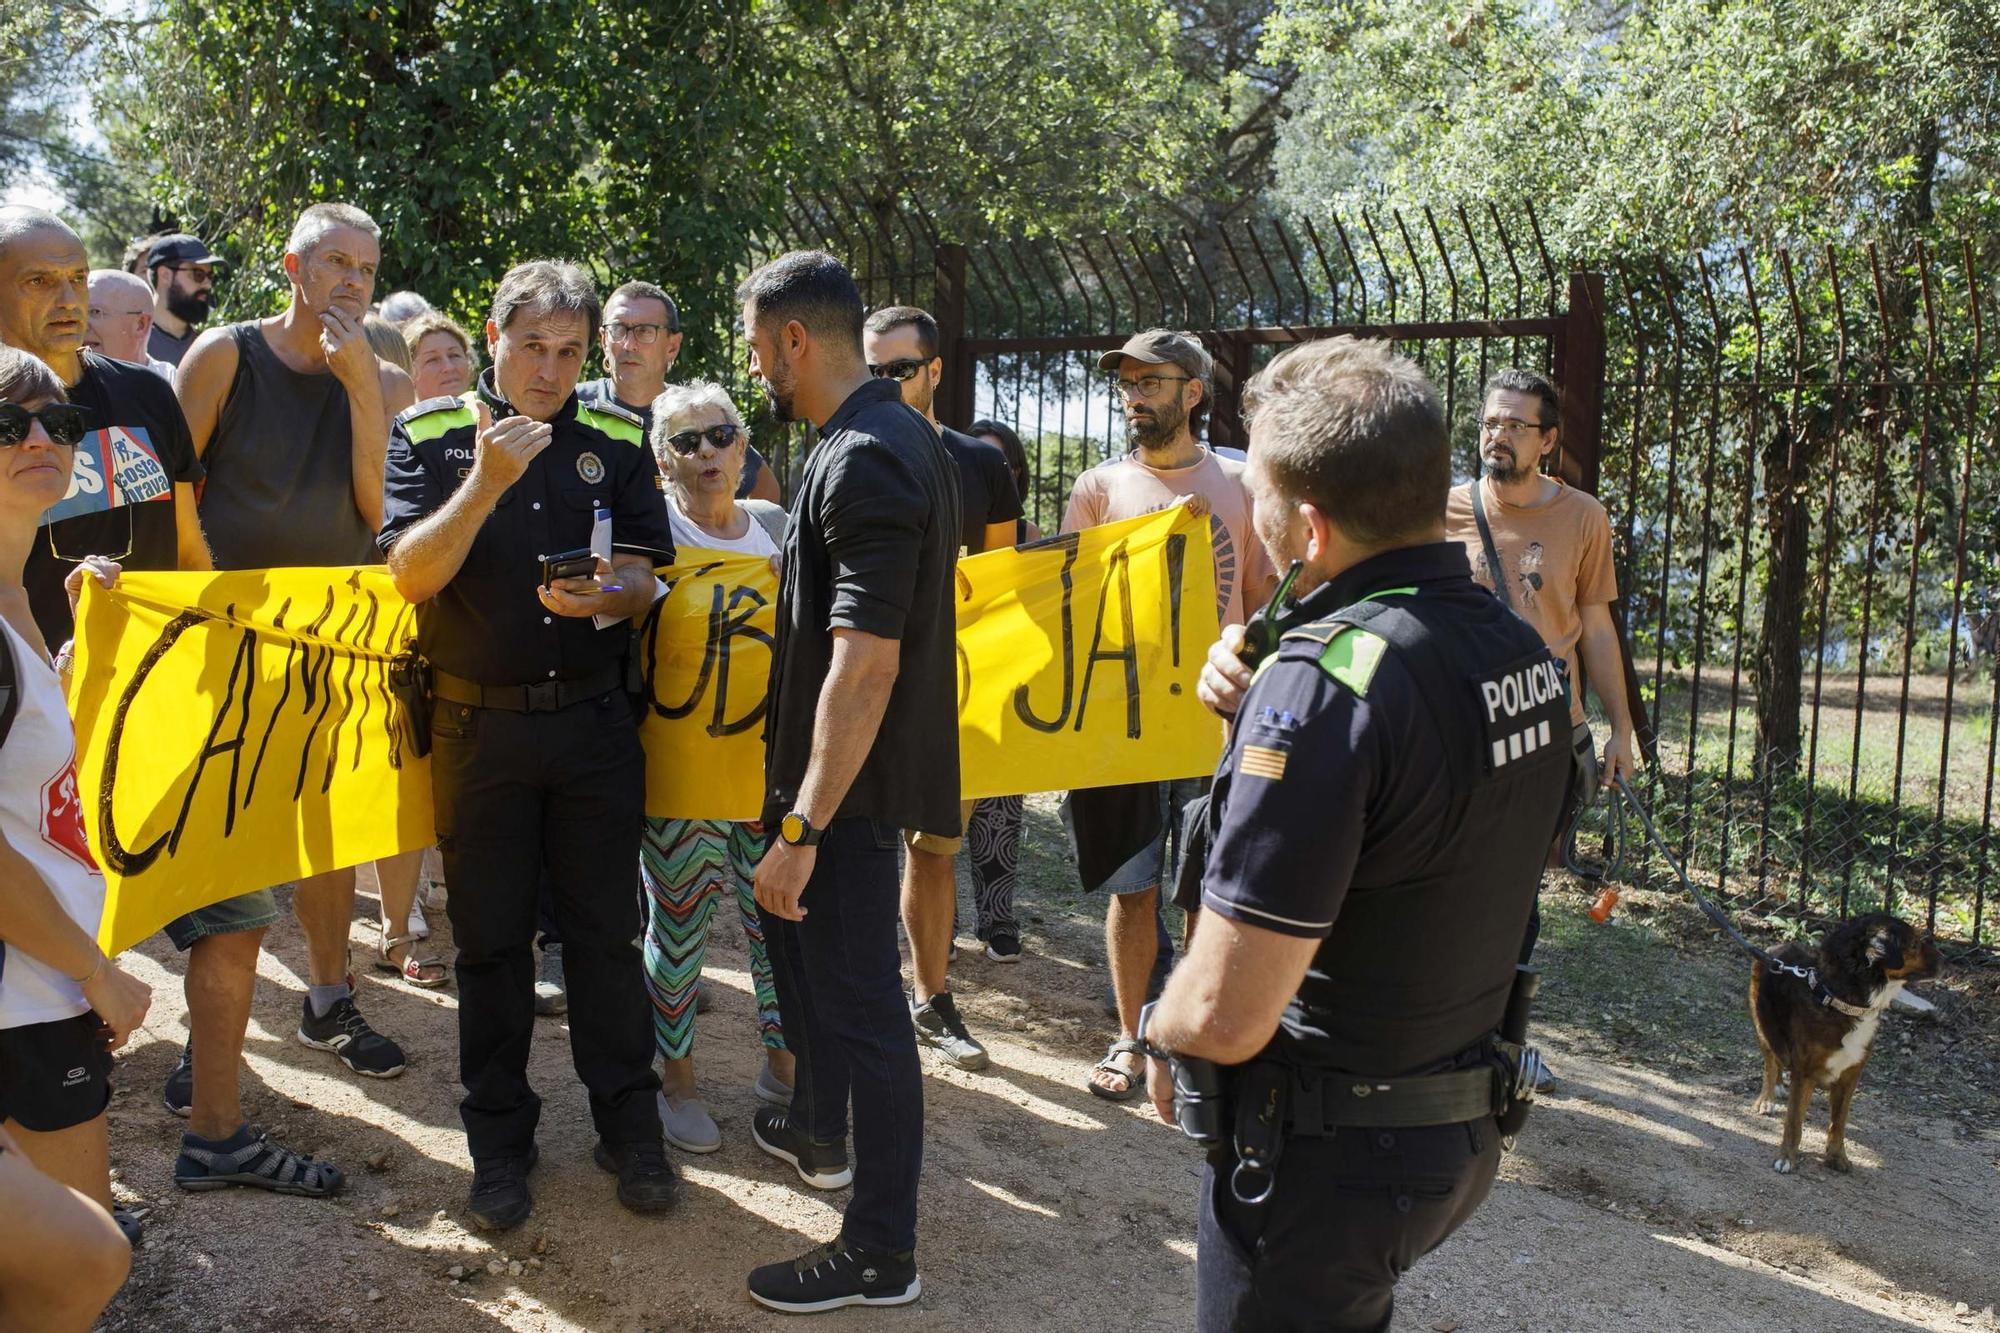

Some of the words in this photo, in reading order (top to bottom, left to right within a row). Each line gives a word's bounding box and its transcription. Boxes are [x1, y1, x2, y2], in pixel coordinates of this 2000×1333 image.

[113, 458, 160, 489] costa
[444, 448, 474, 460] POL
[1014, 531, 1188, 740] JA!
[1481, 660, 1564, 723] POLICIA
